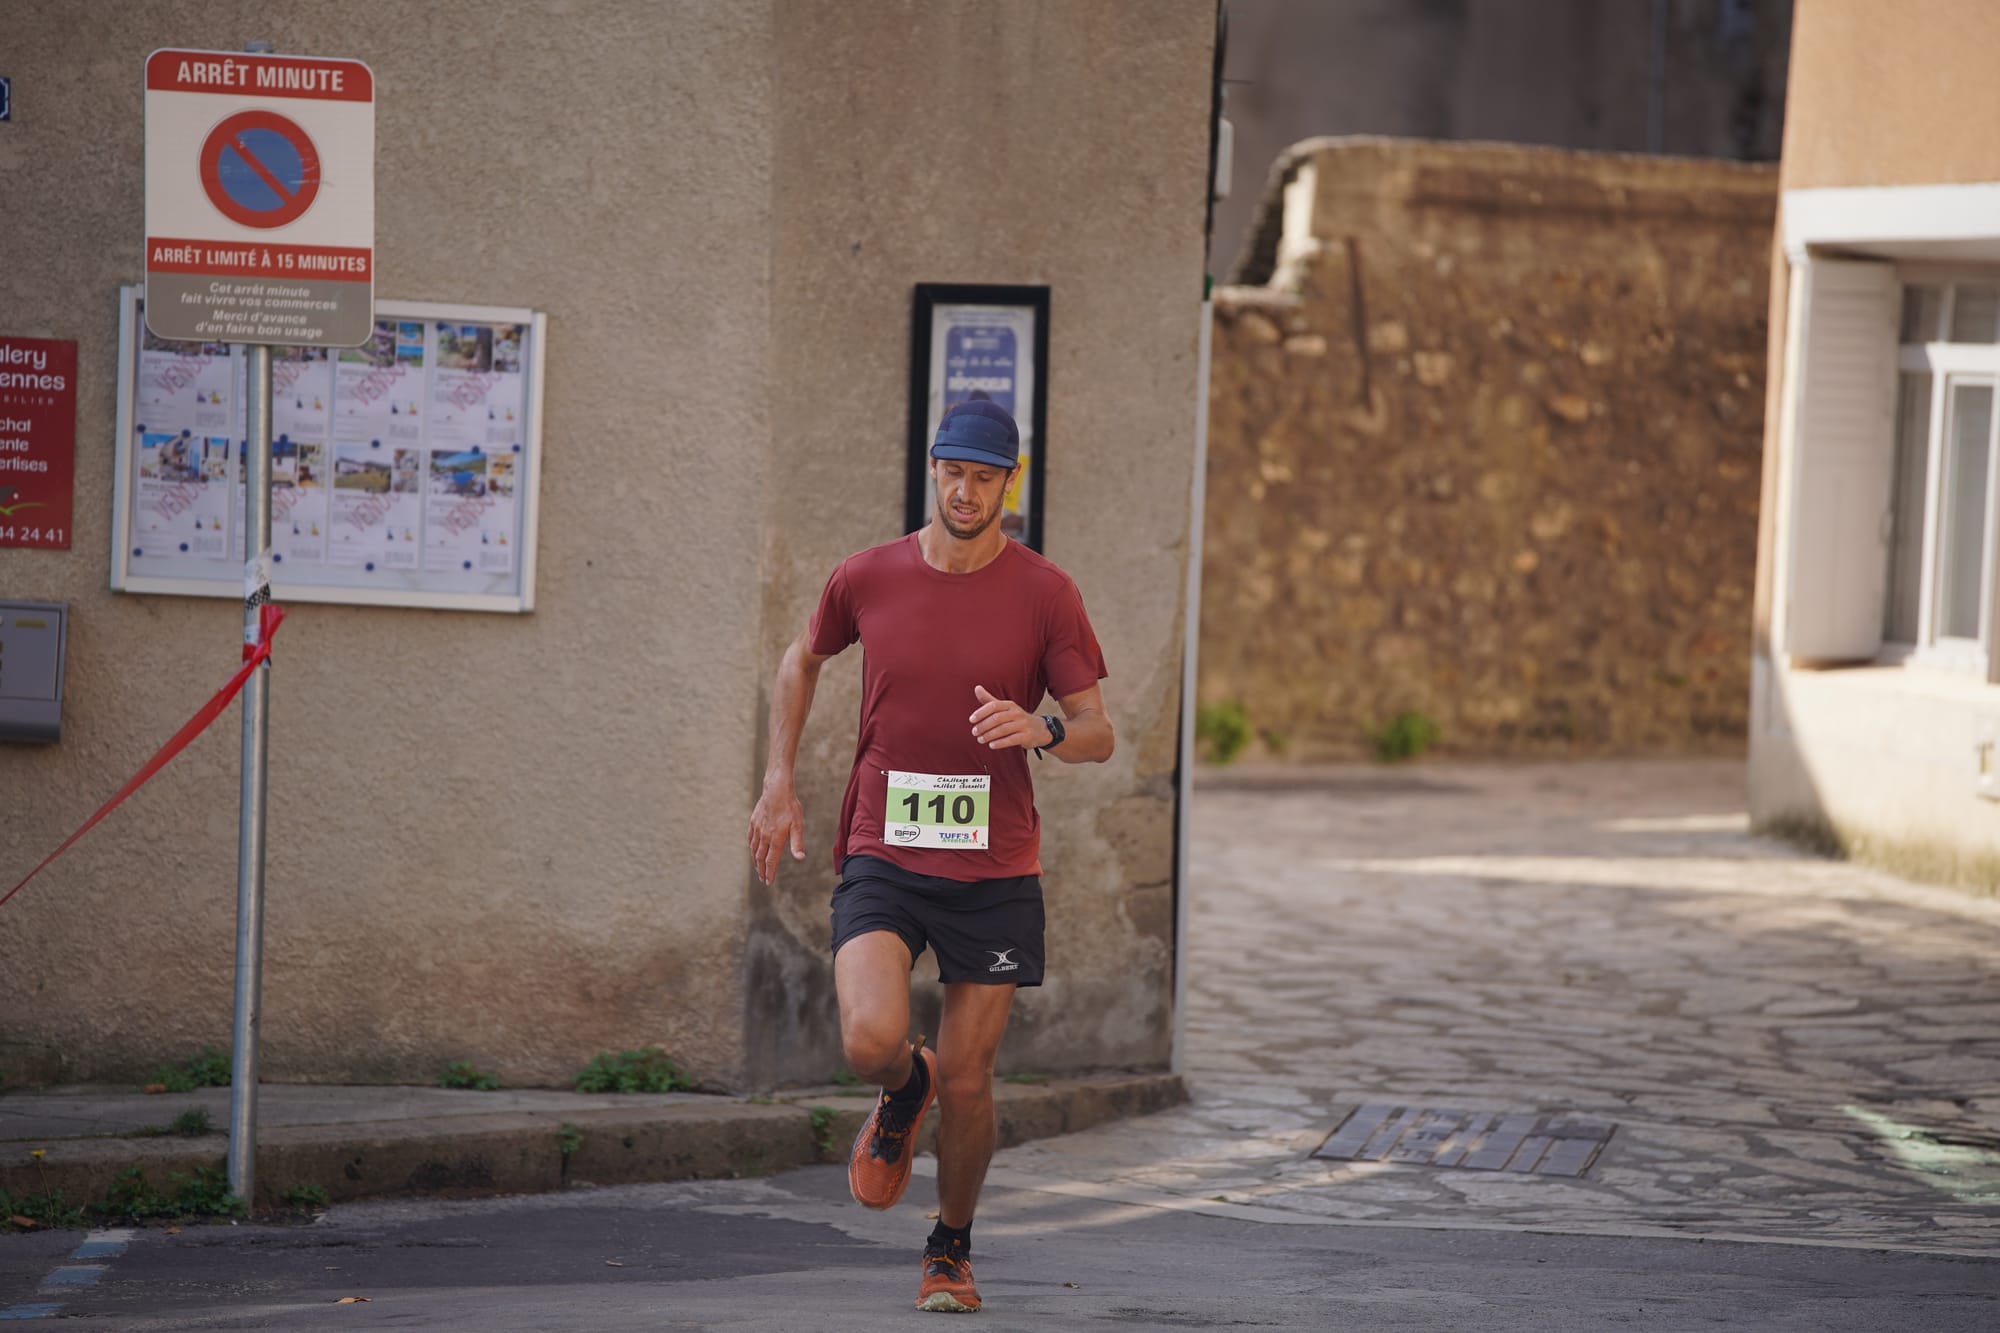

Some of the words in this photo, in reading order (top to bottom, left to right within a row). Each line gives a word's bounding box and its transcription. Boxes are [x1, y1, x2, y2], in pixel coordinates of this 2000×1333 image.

[177, 58, 250, 86] ARRÊT
[256, 66, 344, 92] MINUTE
[153, 246, 202, 265] ARRÊT
[206, 249, 257, 267] LIMITÉ
[261, 250, 271, 268] À
[276, 254, 294, 269] 15
[297, 255, 366, 273] MINUTES
[209, 282, 232, 294] Cet
[233, 283, 265, 296] arrêt
[266, 286, 311, 298] minute
[181, 292, 202, 304] fait
[204, 295, 236, 306] vivre
[238, 297, 262, 307] vos
[264, 299, 337, 310] commerces
[212, 310, 248, 322] Merci
[251, 312, 307, 325] d'avance
[195, 323, 223, 334] d'en
[225, 323, 255, 336] faire
[257, 325, 283, 338] bon
[284, 328, 323, 341] usage
[20, 526, 40, 542] 24
[45, 528, 63, 544] 41
[902, 792, 975, 824] 110
[939, 832, 970, 840] TUFF'S
